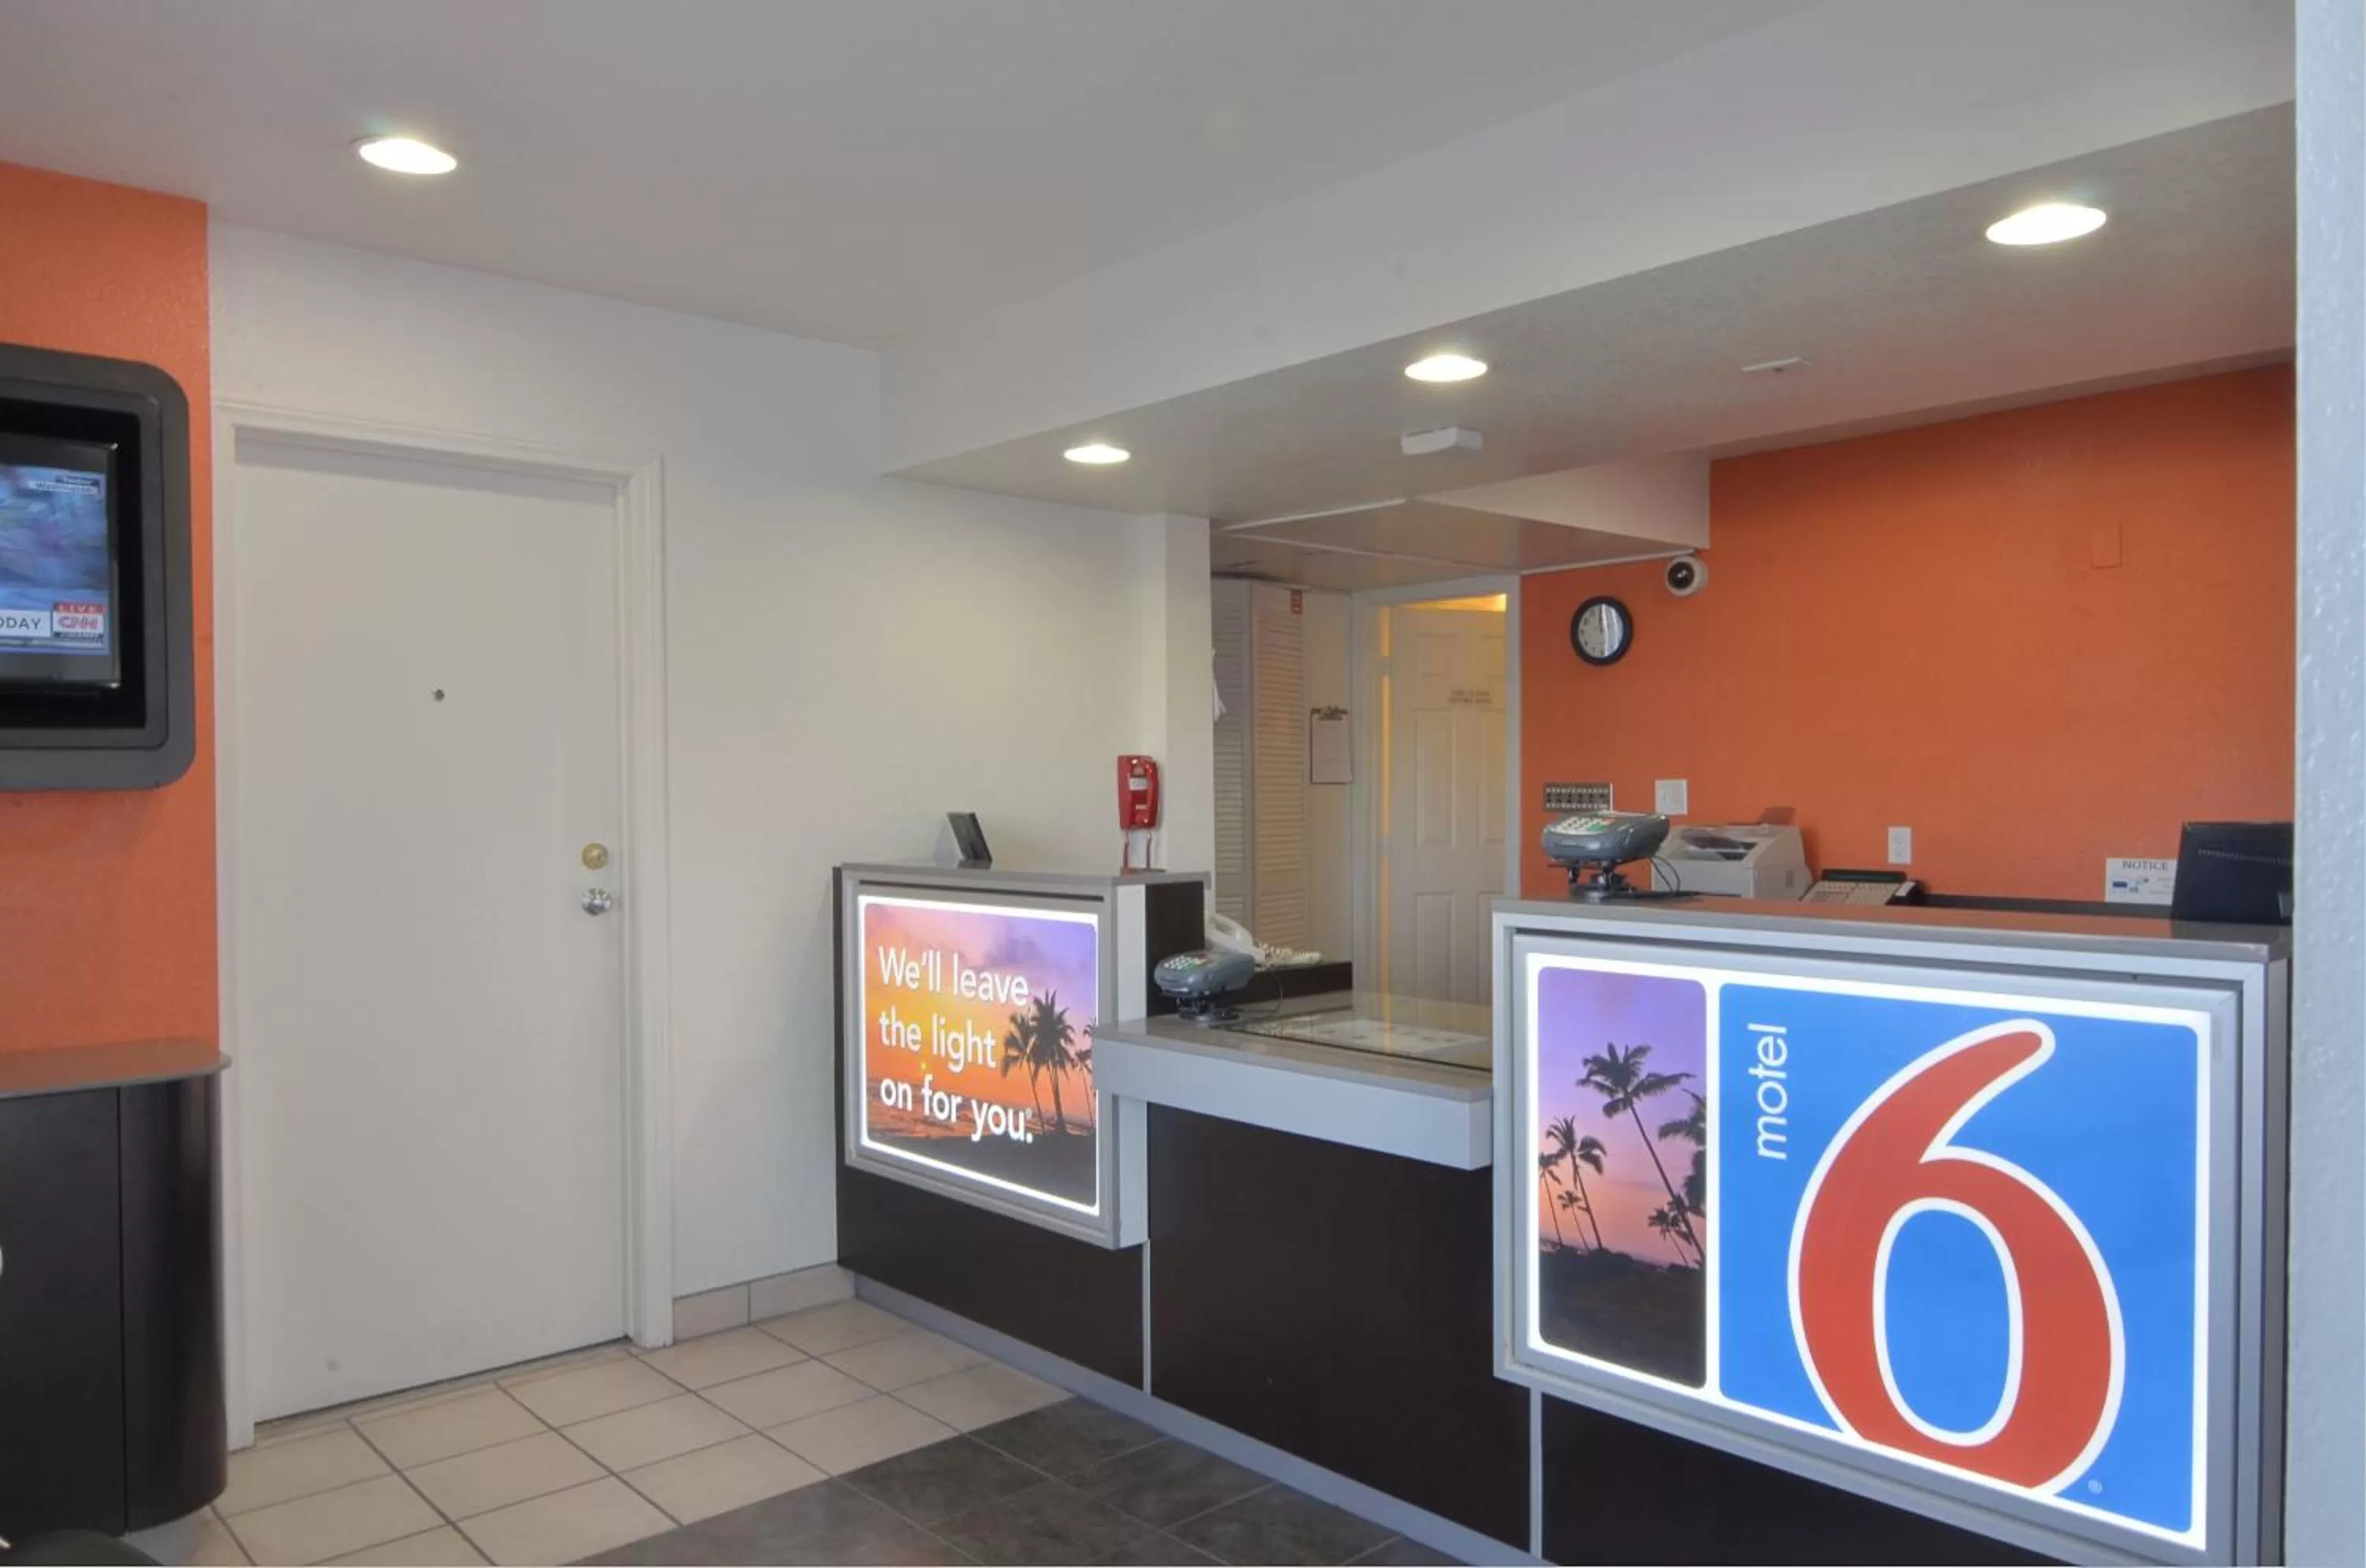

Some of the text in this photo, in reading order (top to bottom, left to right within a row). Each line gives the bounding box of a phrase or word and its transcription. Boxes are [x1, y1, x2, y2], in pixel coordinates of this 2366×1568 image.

[2122, 860, 2170, 871] NOTICE
[879, 946, 1028, 1006] We'll leave
[879, 1006, 996, 1073] the light
[881, 1077, 912, 1111] on
[921, 1073, 961, 1123] for
[1748, 1023, 1787, 1160] motel
[1787, 1018, 2125, 1496] 6
